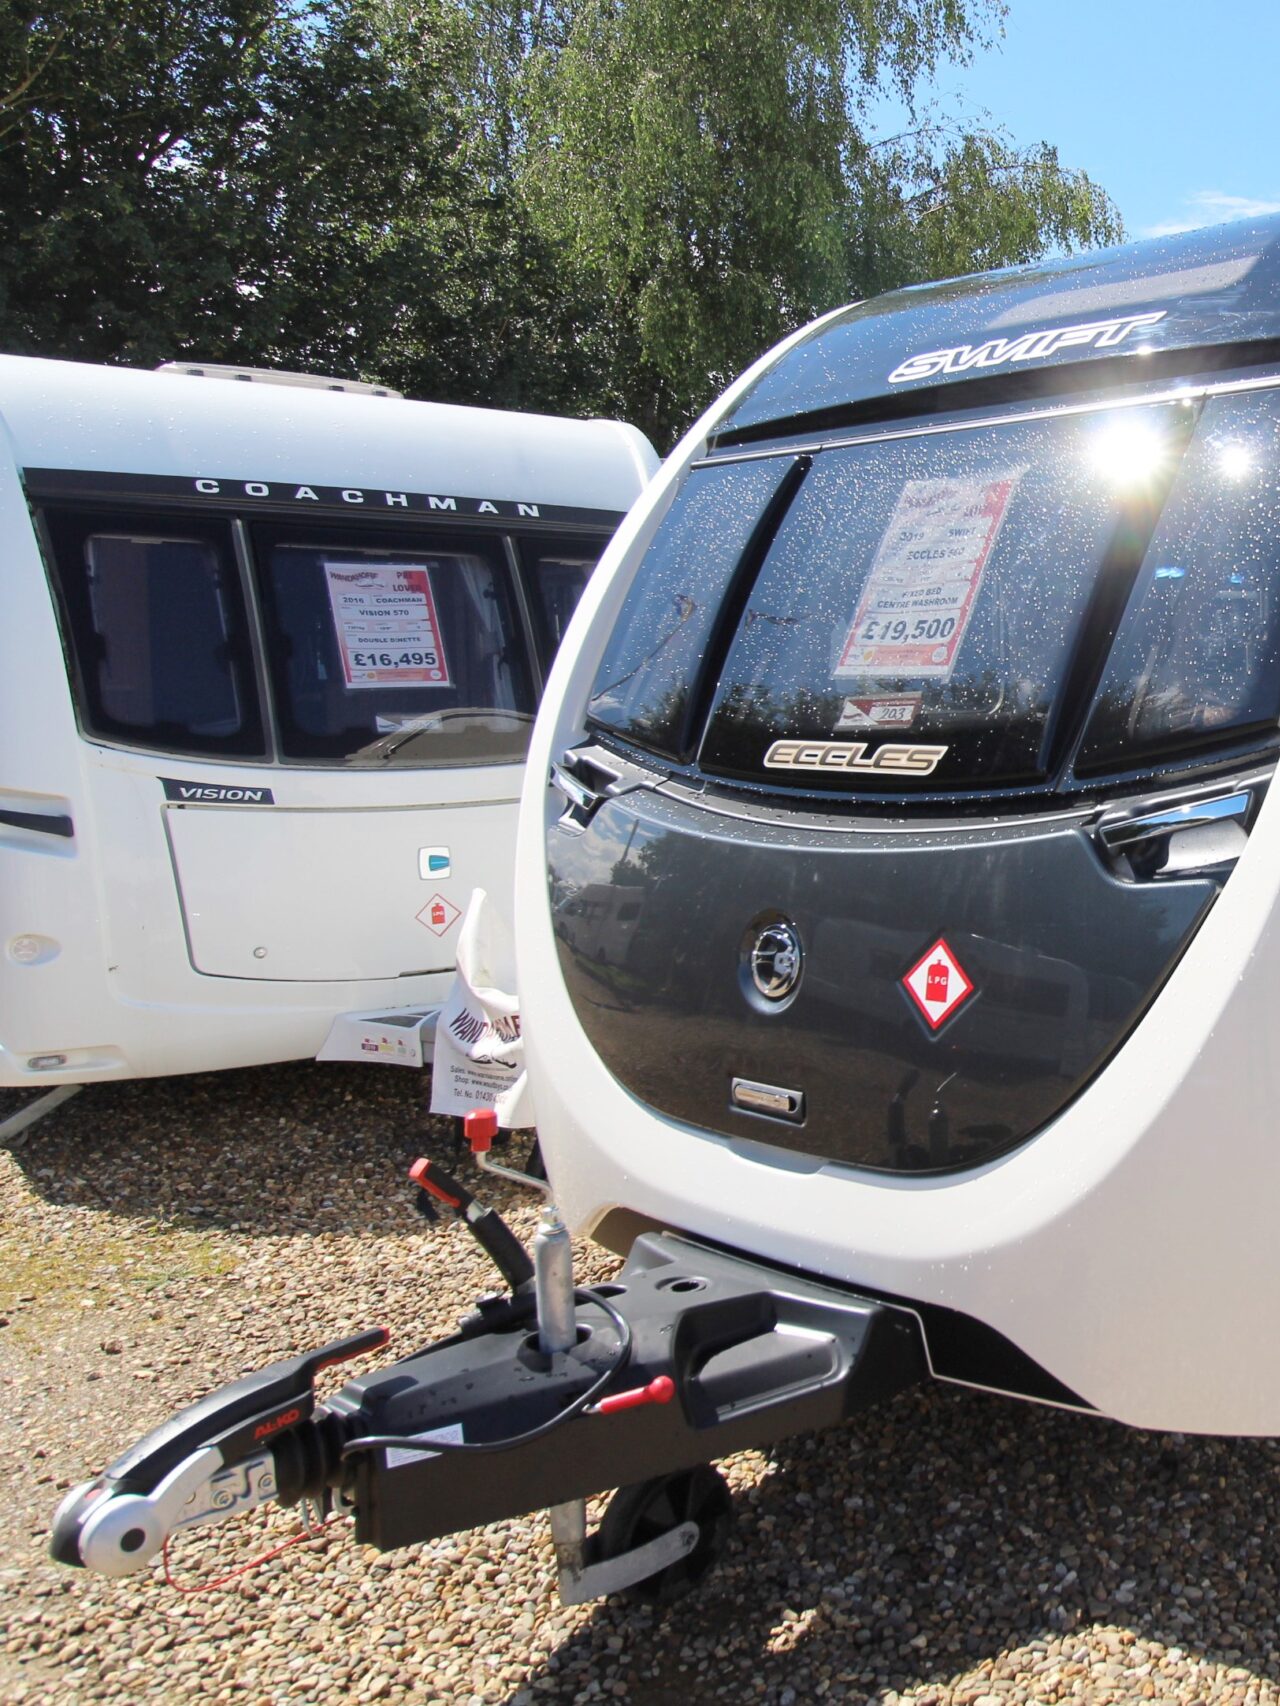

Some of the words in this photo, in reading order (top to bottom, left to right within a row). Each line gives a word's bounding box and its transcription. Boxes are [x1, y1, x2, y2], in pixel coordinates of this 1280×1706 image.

[888, 311, 1167, 383] SWIFT
[195, 479, 540, 518] COACHMAN
[906, 549, 945, 560] ECCLES
[925, 587, 942, 596] BED
[343, 596, 364, 604] 2016
[877, 600, 912, 609] CENTRE
[912, 597, 959, 607] WASHROOM
[861, 617, 956, 643] £19,500
[354, 652, 436, 668] £16,495
[764, 741, 948, 774] ECCLES
[179, 787, 263, 801] VISION
[928, 975, 947, 986] LPG
[254, 1408, 300, 1440] AL-KO
